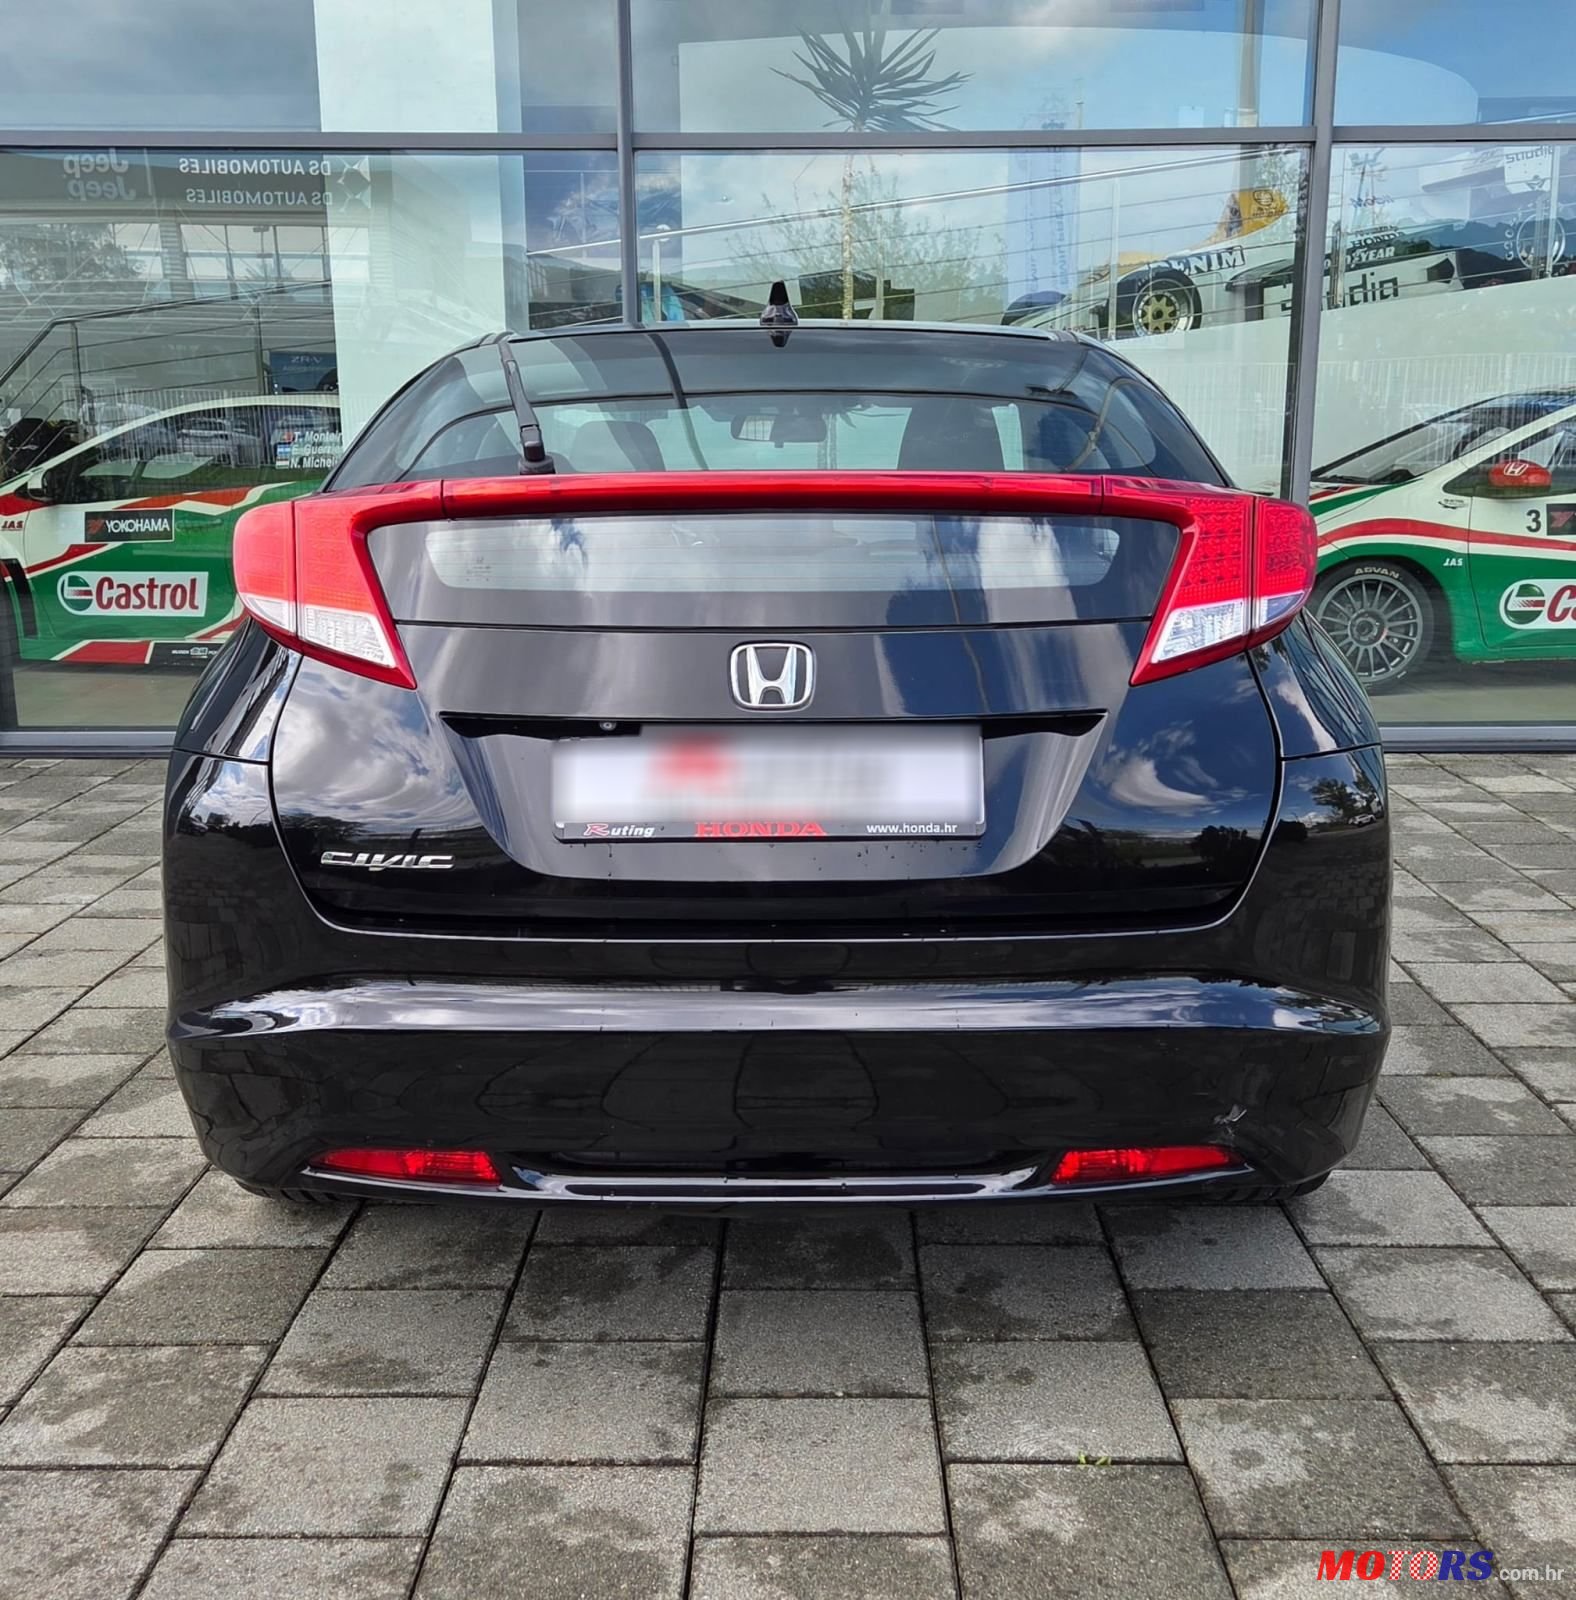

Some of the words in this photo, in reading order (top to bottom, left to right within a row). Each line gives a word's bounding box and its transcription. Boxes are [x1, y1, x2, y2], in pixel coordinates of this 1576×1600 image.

[106, 518, 170, 533] YOKOHAMA
[1526, 509, 1542, 533] 3
[1354, 566, 1399, 579] ADVAN
[96, 576, 199, 610] Castrol
[584, 823, 655, 838] Ruting
[695, 822, 827, 837] HONDA
[866, 822, 958, 835] www.honda.hr
[321, 851, 453, 871] CIVIC
